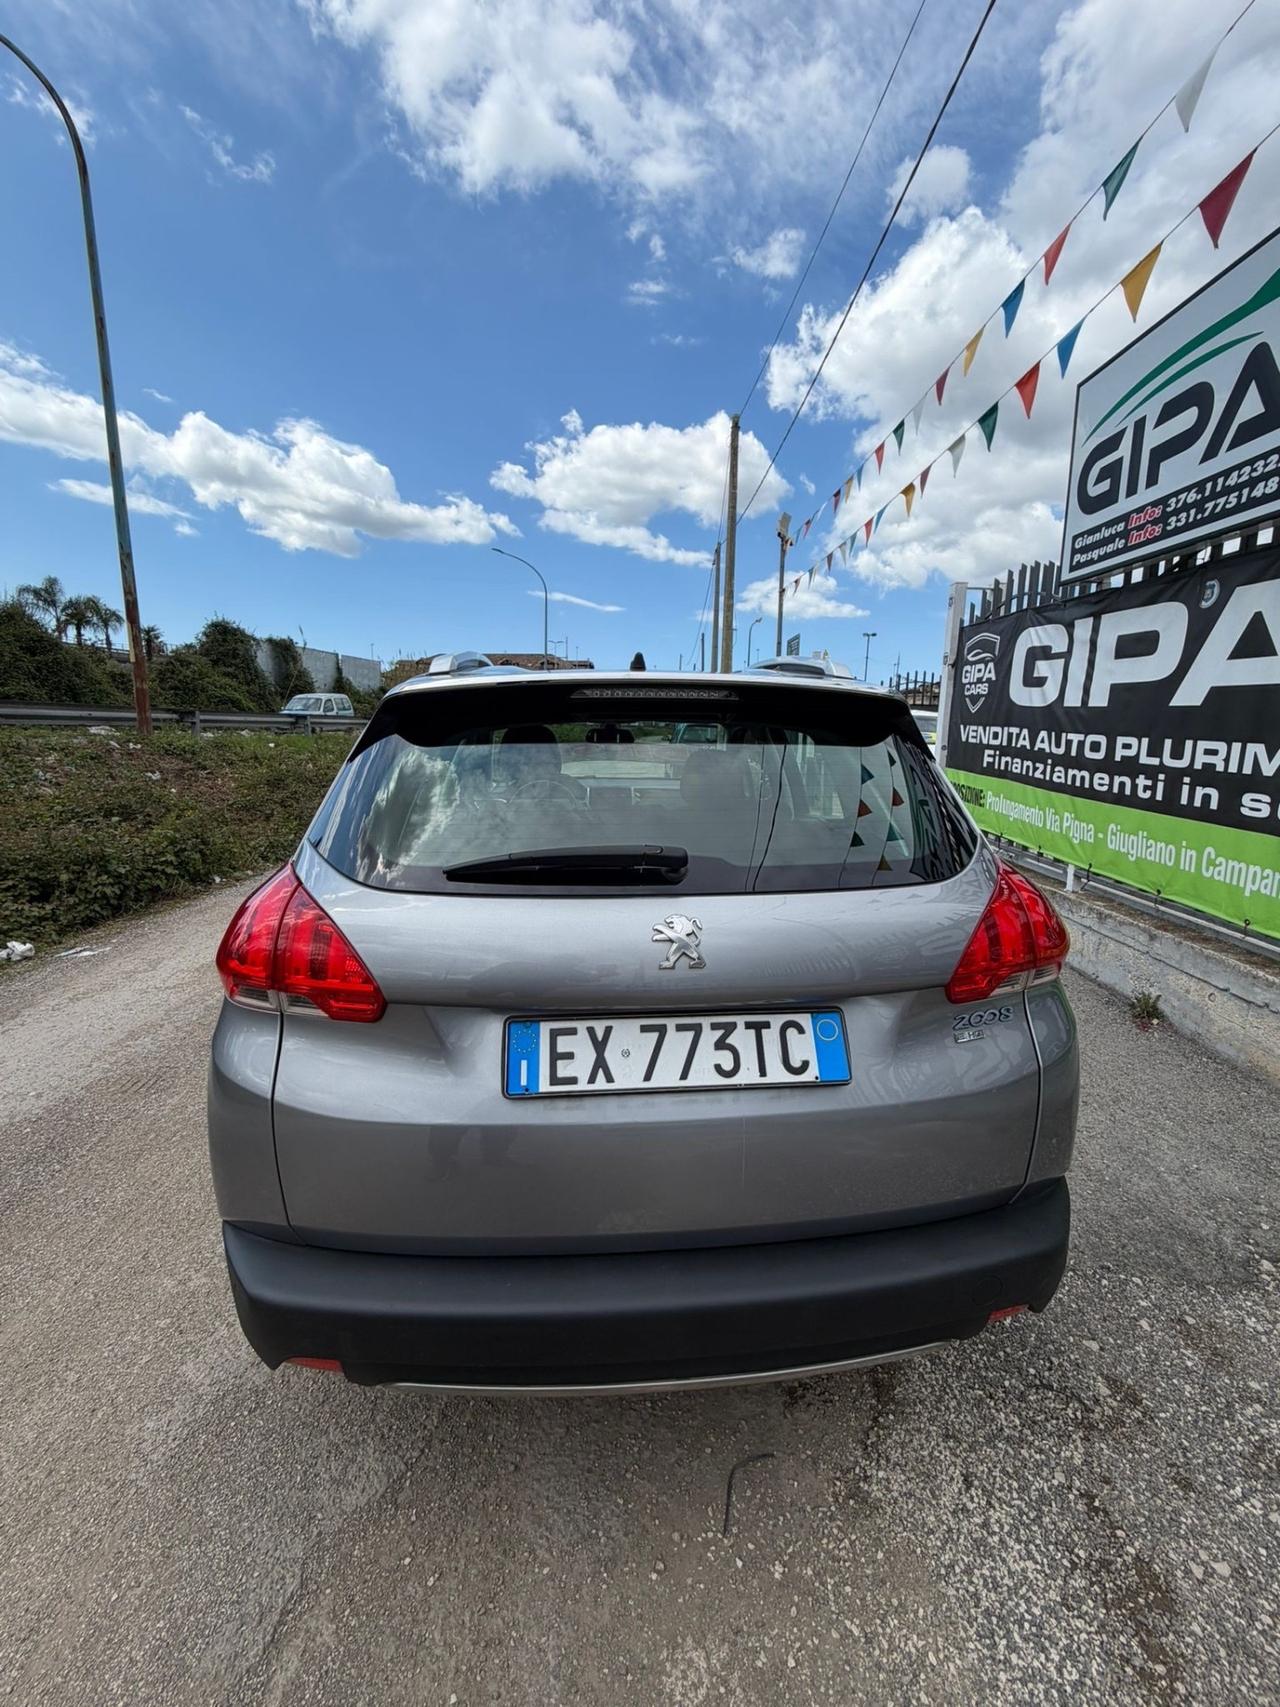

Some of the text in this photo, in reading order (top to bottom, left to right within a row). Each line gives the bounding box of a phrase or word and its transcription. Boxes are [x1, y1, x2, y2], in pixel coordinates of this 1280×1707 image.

[1077, 341, 1280, 515] GIPA
[1074, 454, 1280, 548] Gianluca Info: 376.114232
[1072, 538, 1126, 566] Pasquale
[1127, 522, 1163, 546] Info:
[961, 662, 996, 683] GIPA
[1009, 578, 1280, 707] GIPA
[964, 682, 988, 696] CARS
[960, 725, 1280, 777] VENDITA AUTO PLURIM
[982, 749, 1280, 820] Finanziamenti in s
[986, 790, 1044, 828] Prolungamento
[1046, 806, 1060, 833] Via
[1062, 812, 1095, 844] Pigna
[1107, 823, 1176, 867] Giugliano
[1179, 842, 1196, 873] in
[952, 1006, 1014, 1030] 2008
[549, 1019, 810, 1086] EX 773TC
